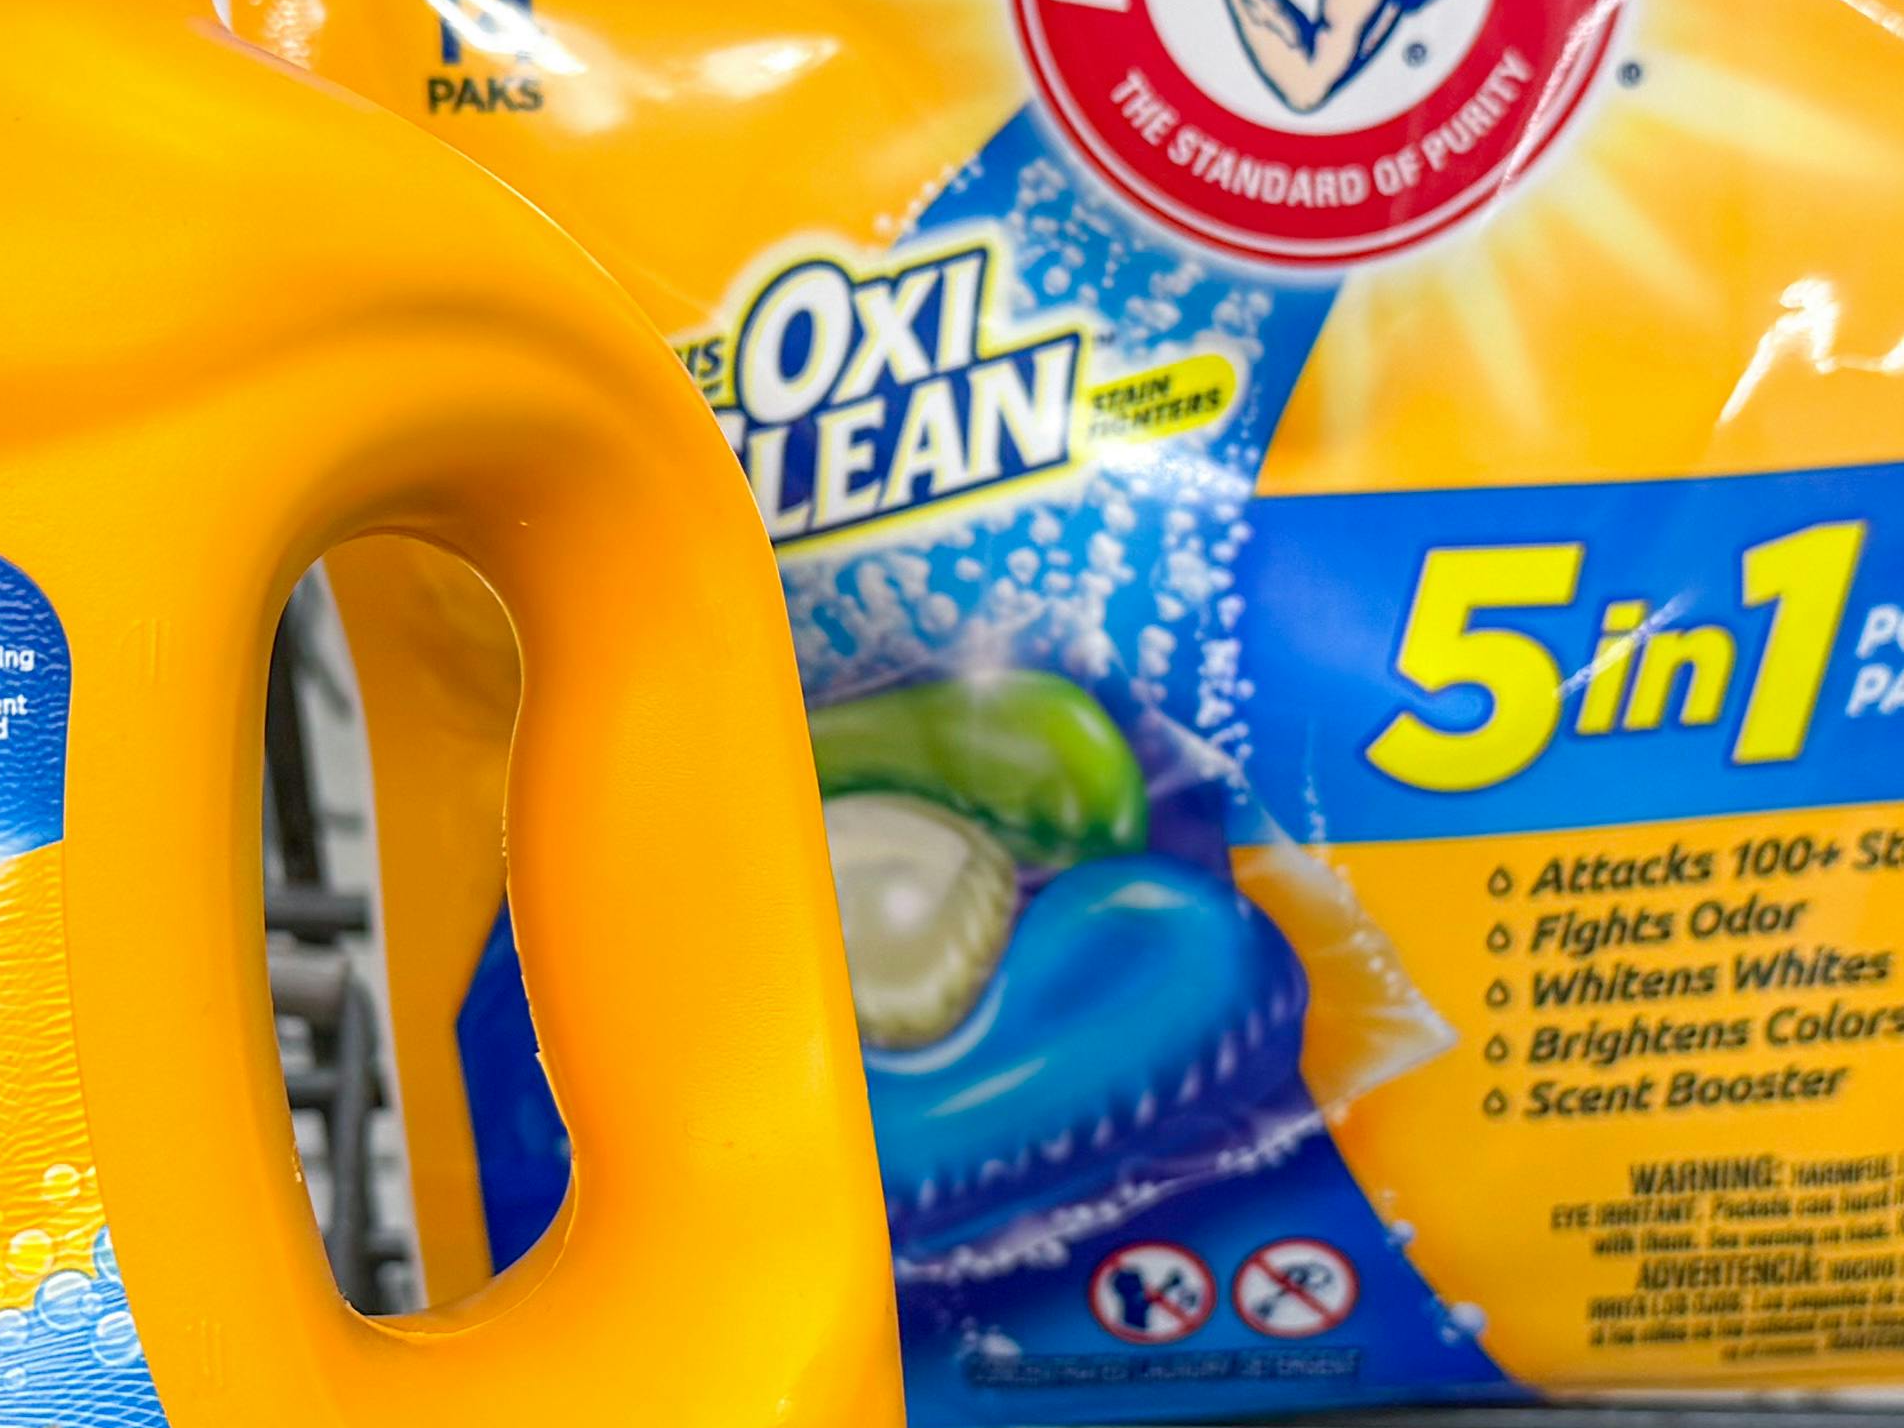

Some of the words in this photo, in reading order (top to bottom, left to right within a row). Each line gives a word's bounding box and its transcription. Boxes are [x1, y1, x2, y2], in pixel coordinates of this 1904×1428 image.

[427, 74, 544, 114] PAKS
[1110, 69, 1177, 146] THE
[1167, 128, 1368, 208] STANDARD
[1374, 149, 1418, 194] OF
[1420, 49, 1533, 170] PURITY
[739, 249, 986, 423] OXI
[1532, 841, 1713, 896] Attacks
[1734, 837, 1840, 879] 100+
[1531, 912, 1673, 958] Fights
[1689, 893, 1809, 940] Odor
[1531, 961, 1717, 1010] Whitens
[1734, 948, 1892, 991] Whites
[1528, 1017, 1749, 1066] Brightens
[1525, 1076, 1653, 1118] Scent
[1668, 1068, 1851, 1108] Booster
